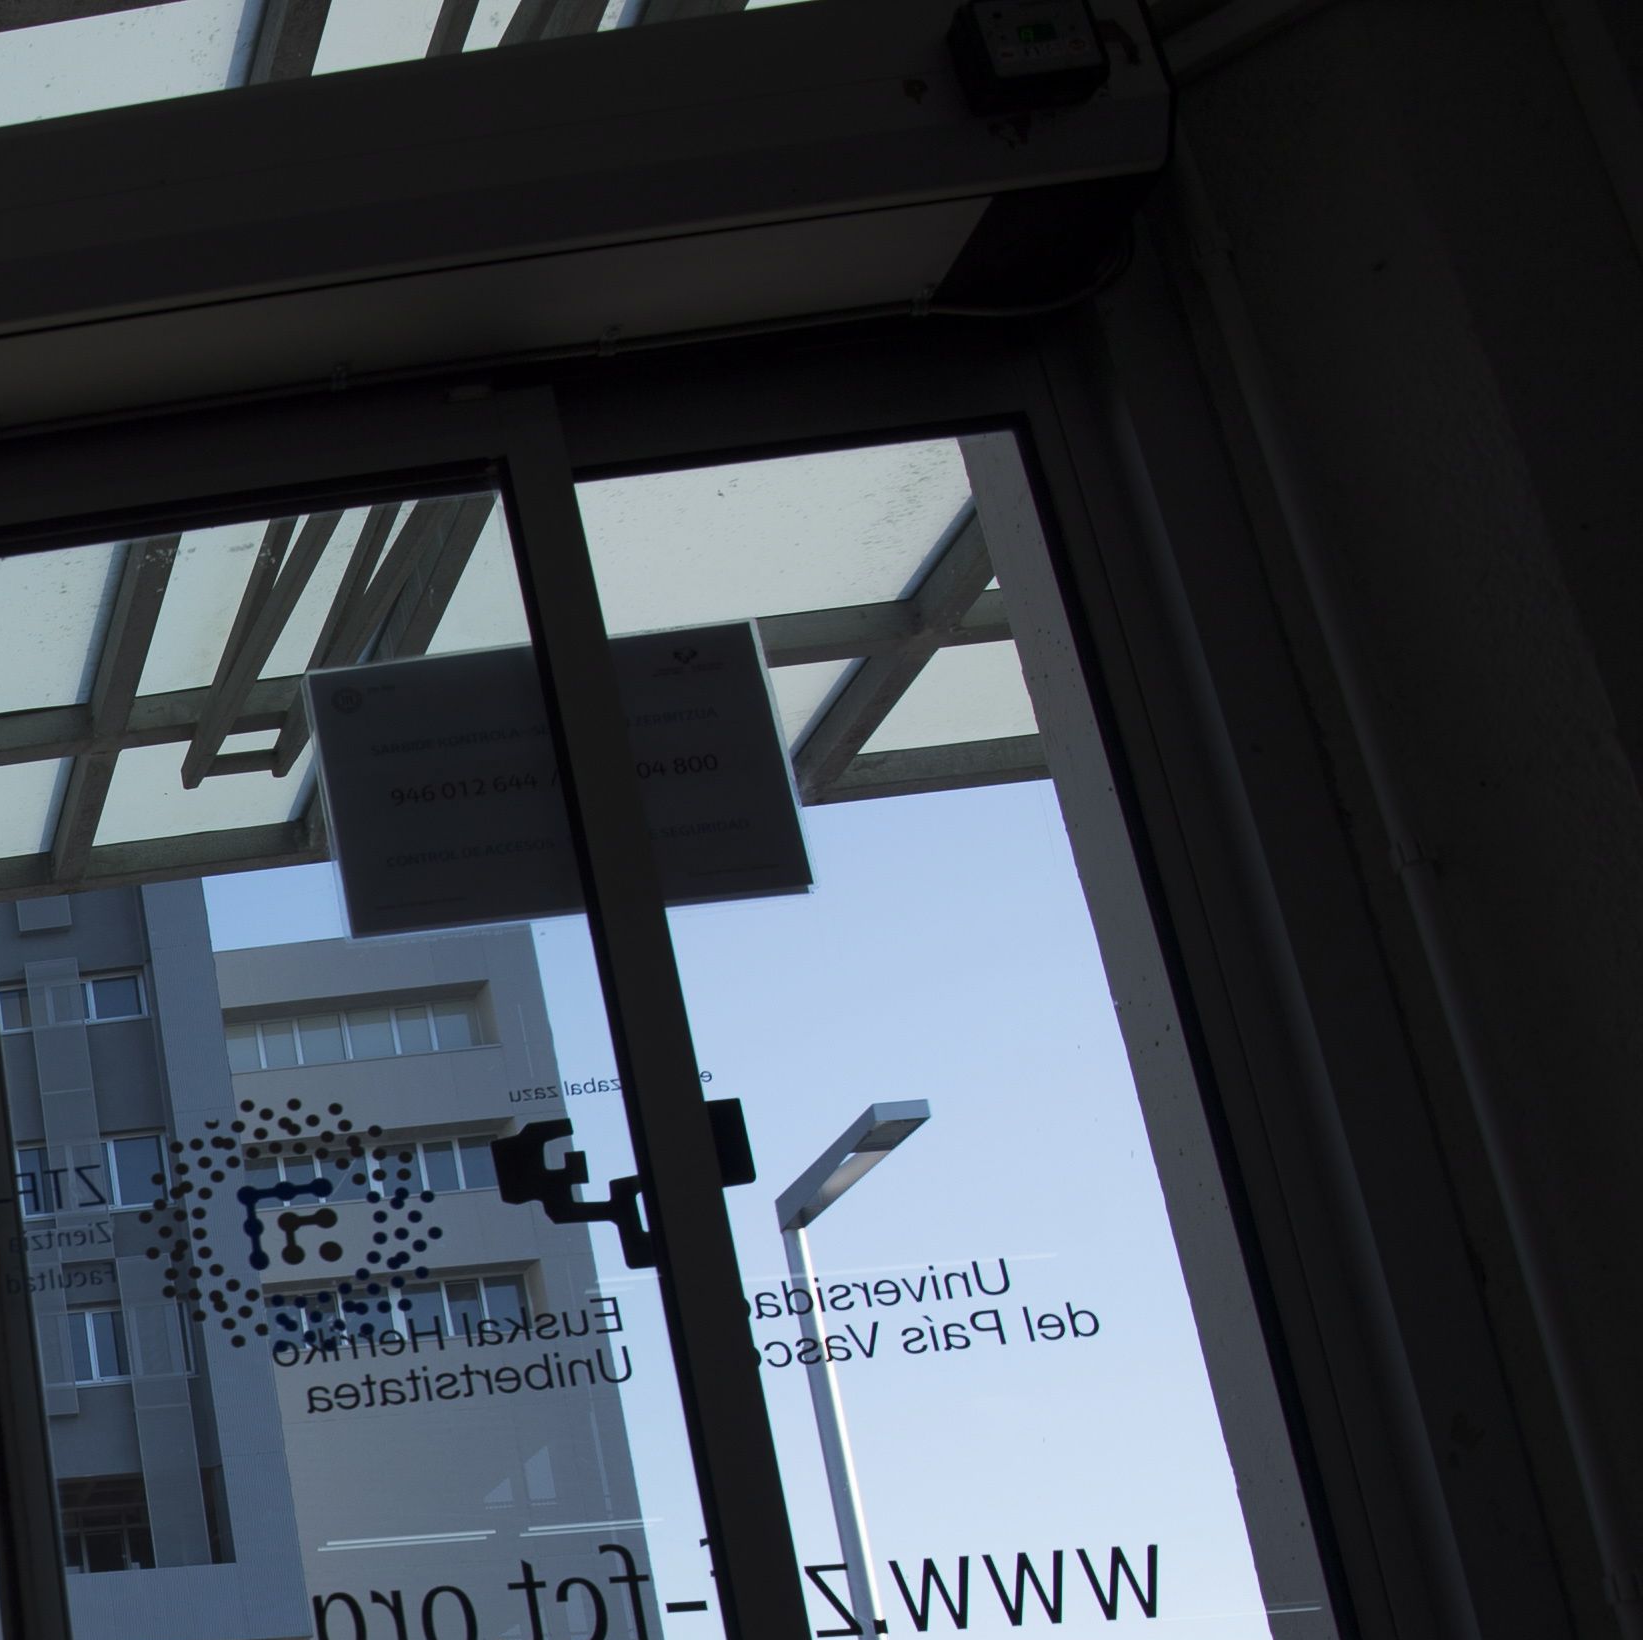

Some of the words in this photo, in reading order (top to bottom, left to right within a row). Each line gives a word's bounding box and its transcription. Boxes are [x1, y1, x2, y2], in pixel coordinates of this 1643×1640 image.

[390, 784, 436, 807] 946
[440, 778, 486, 801] 012
[492, 773, 538, 794] 644
[635, 760, 668, 780] 04
[672, 753, 719, 775] 800
[386, 849, 459, 869] CONTROL
[659, 817, 751, 839] SEGURIDAD
